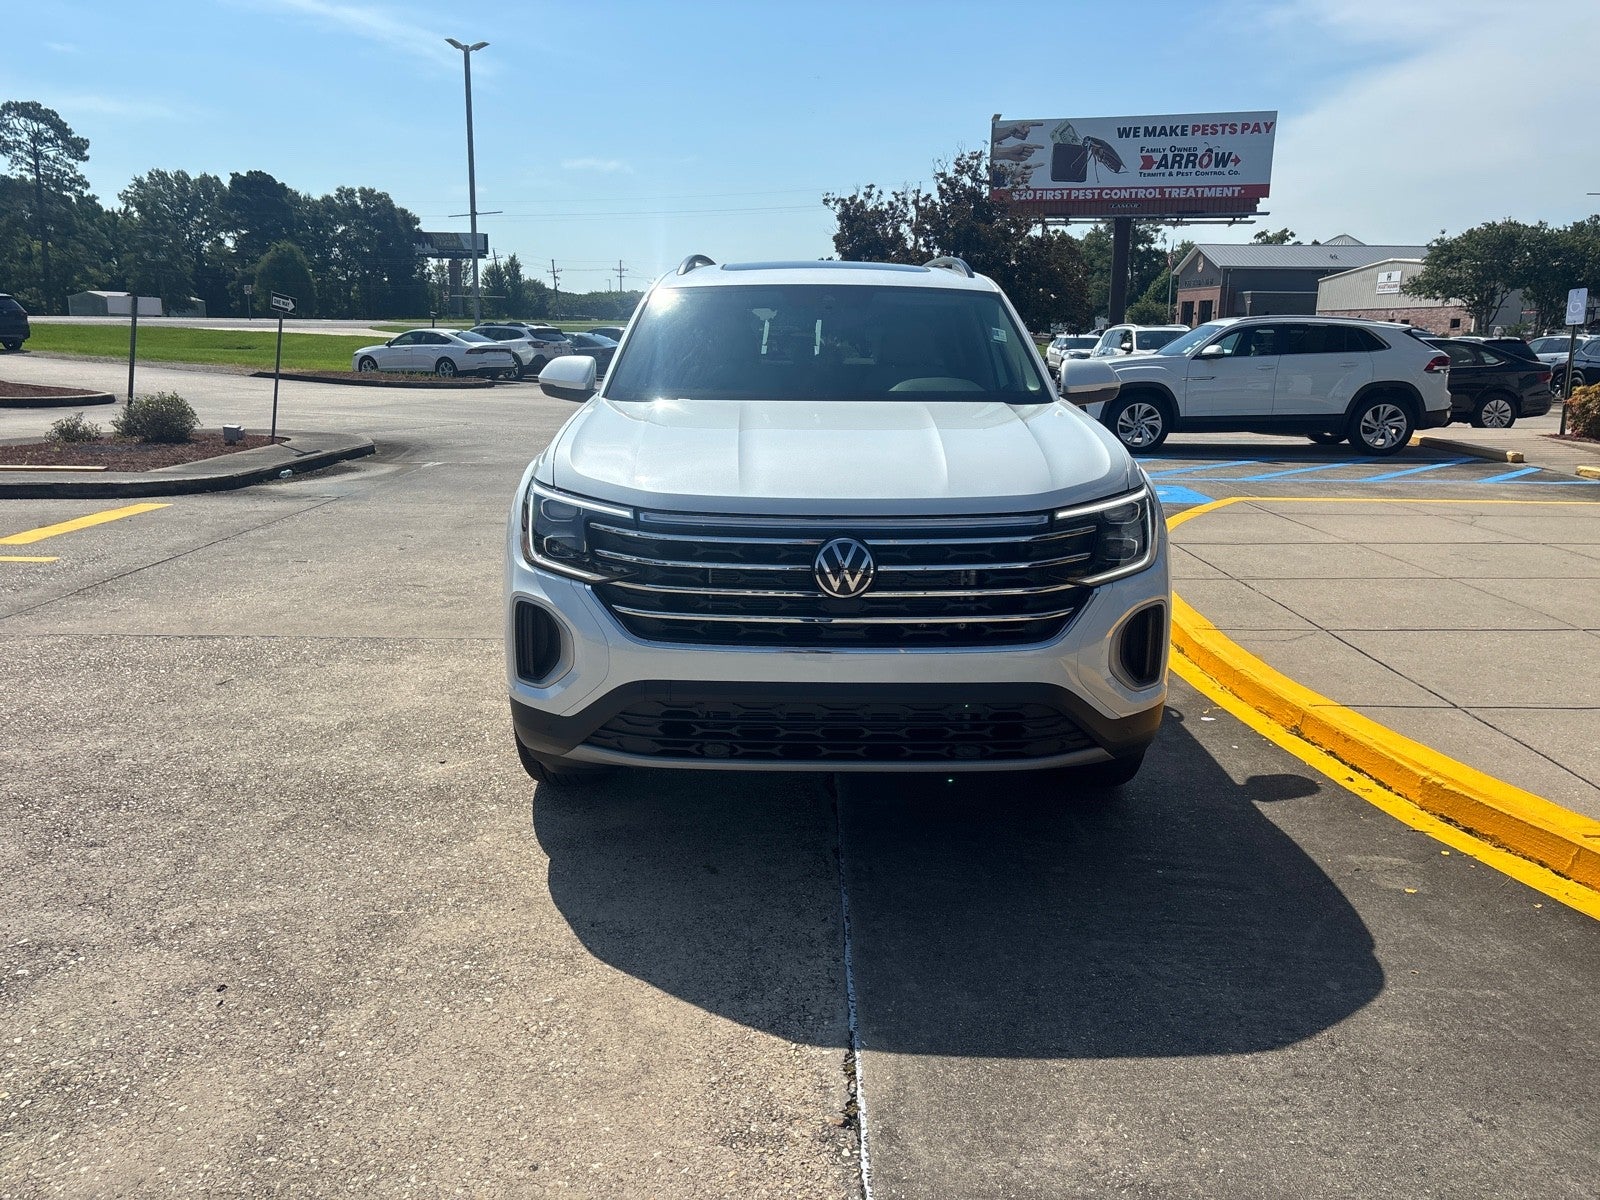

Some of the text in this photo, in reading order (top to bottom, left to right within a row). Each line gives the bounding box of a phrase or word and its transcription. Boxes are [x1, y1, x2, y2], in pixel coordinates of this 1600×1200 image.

[1117, 121, 1275, 139] WE MAKE PESTS PAY
[1155, 151, 1233, 170] ARROW
[1036, 190, 1070, 200] FIRST
[1071, 189, 1101, 200] PEST
[1102, 188, 1162, 199] CONTROL
